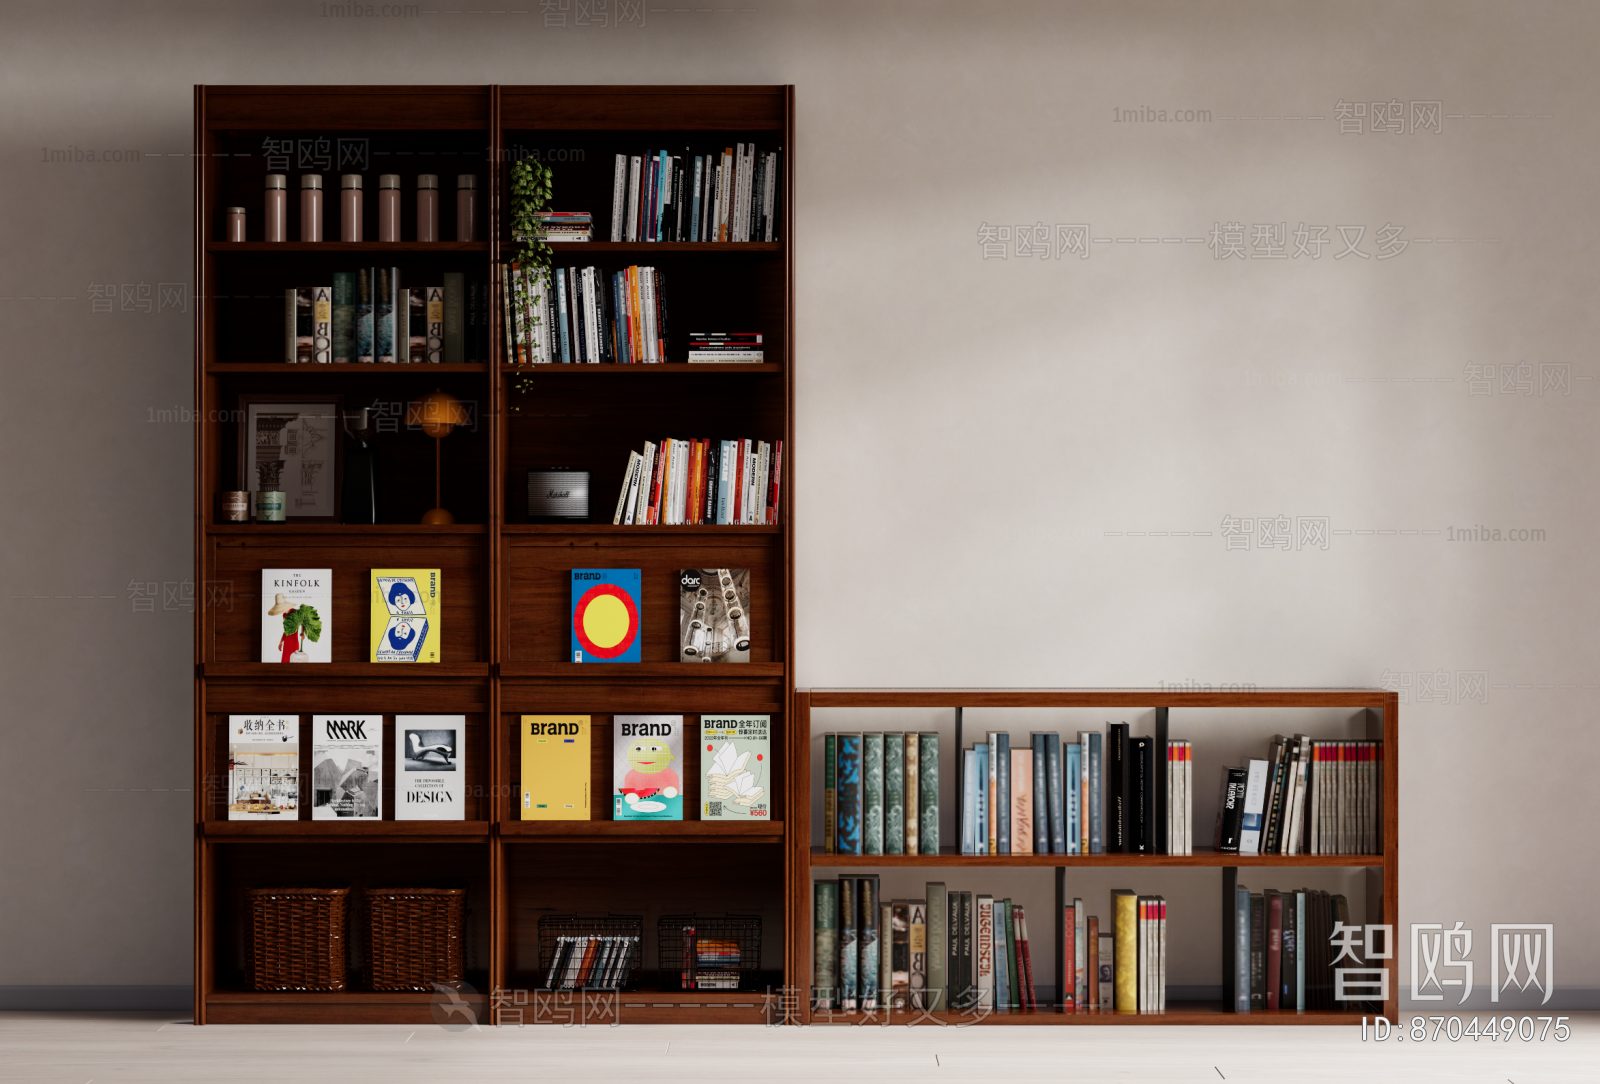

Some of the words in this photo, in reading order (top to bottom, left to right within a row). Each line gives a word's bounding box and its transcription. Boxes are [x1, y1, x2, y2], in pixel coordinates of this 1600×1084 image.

[721, 445, 730, 482] STEAM
[633, 458, 641, 487] MODERN
[274, 579, 320, 588] KINFOLK
[681, 574, 701, 585] darc
[244, 719, 286, 731] 收纳全书
[326, 720, 368, 740] MARK
[407, 791, 453, 803] DESIGN
[749, 809, 768, 817] ¥560
